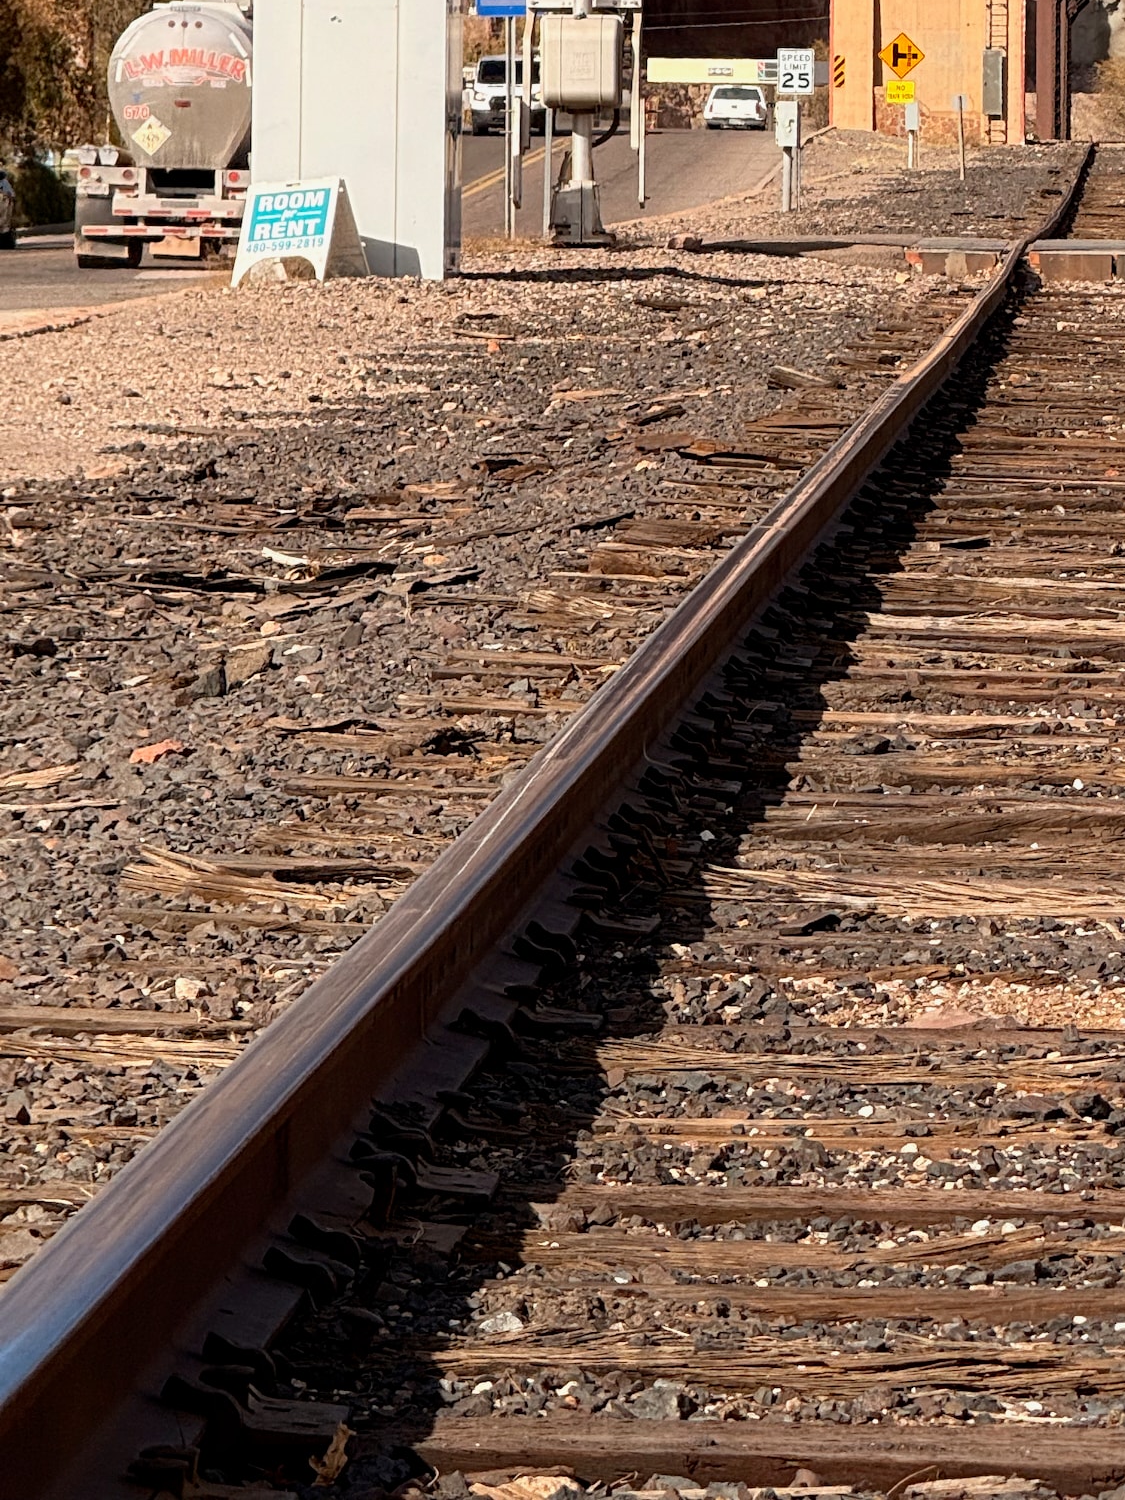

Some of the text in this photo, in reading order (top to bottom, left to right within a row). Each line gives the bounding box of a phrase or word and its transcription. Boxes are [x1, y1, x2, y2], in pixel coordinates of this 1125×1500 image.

[169, 48, 245, 81] MILLER
[781, 54, 811, 62] SPEED
[784, 63, 807, 71] LIMIT
[782, 72, 810, 89] 25
[258, 191, 325, 212] ROOM
[253, 218, 321, 241] RENT
[246, 237, 324, 254] 480-599-2819
